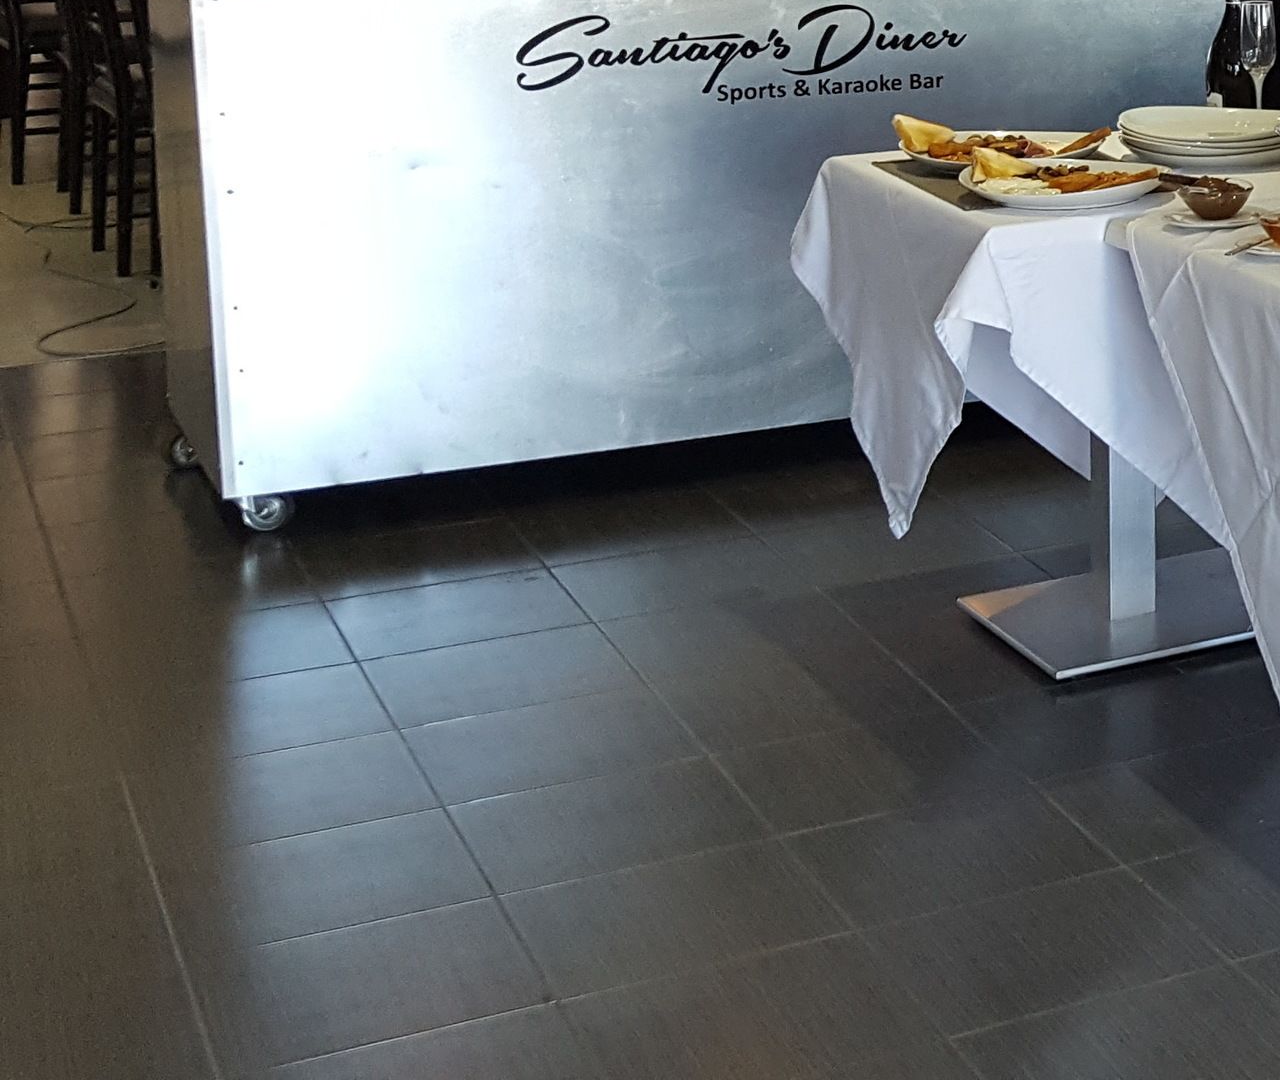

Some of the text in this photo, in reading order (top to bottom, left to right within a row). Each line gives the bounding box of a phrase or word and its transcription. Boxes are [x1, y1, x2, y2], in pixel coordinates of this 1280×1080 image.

[515, 4, 968, 95] Santiago's Diner
[716, 72, 944, 105] Sports & Karaoke Bar
